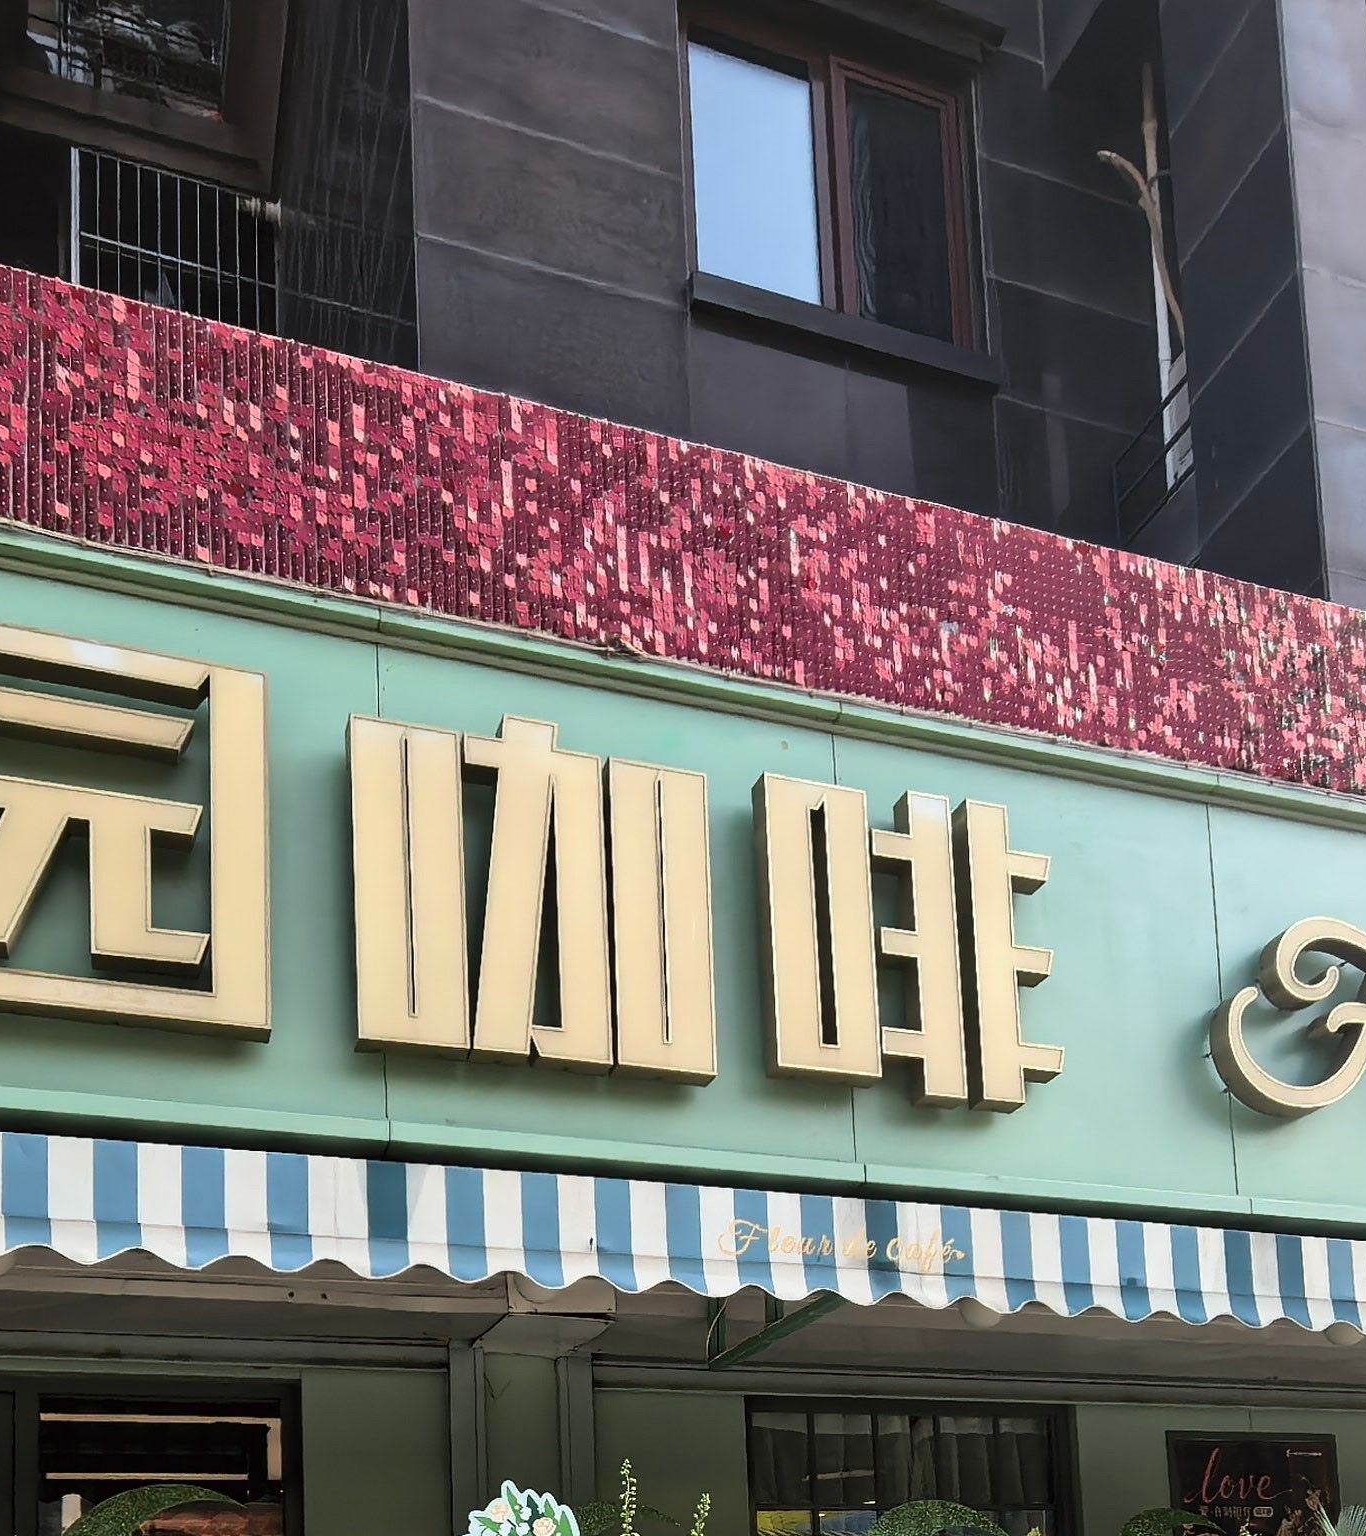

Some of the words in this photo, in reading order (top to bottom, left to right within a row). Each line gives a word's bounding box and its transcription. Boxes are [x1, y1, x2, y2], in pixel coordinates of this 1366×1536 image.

[718, 1218, 834, 1257] Fleur
[842, 1226, 878, 1260] de
[1183, 1447, 1293, 1504] love
